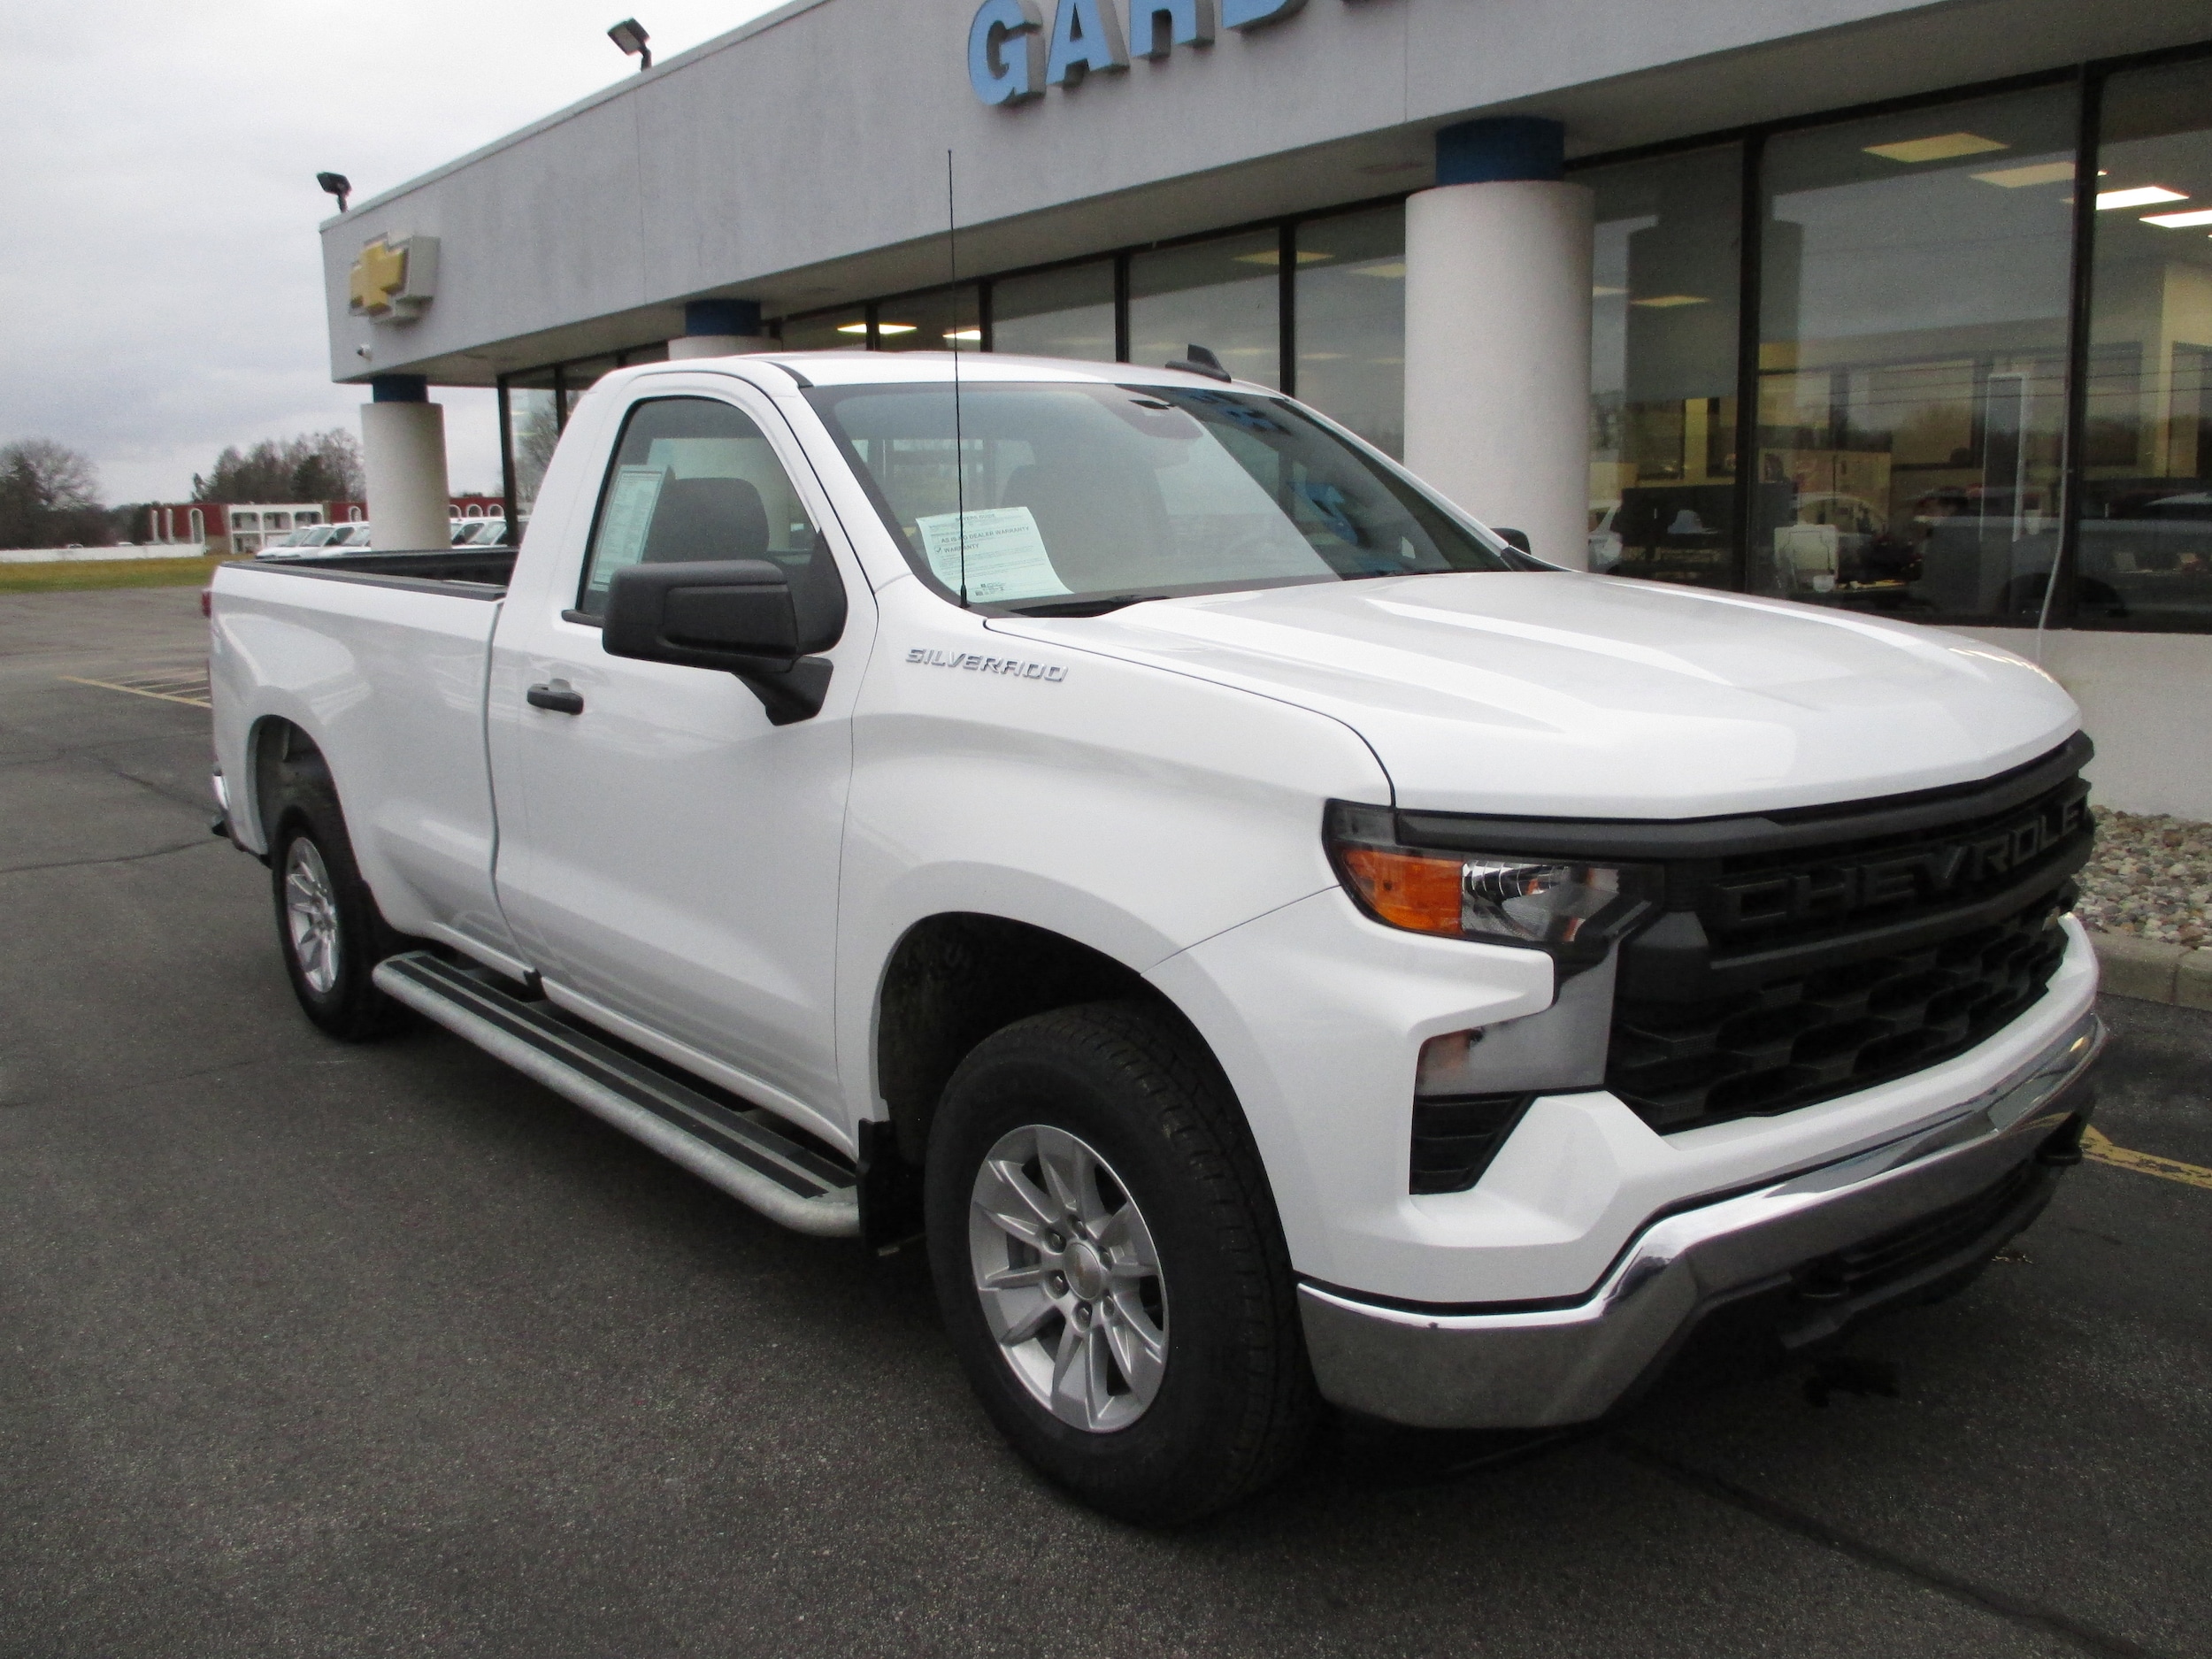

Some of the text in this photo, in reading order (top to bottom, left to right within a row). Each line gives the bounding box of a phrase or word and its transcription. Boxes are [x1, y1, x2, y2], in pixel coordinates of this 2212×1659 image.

[968, 0, 1297, 104] GAR
[970, 531, 994, 540] DEALER
[995, 526, 1029, 535] WARRANTY
[905, 648, 1070, 682] SILVERADO
